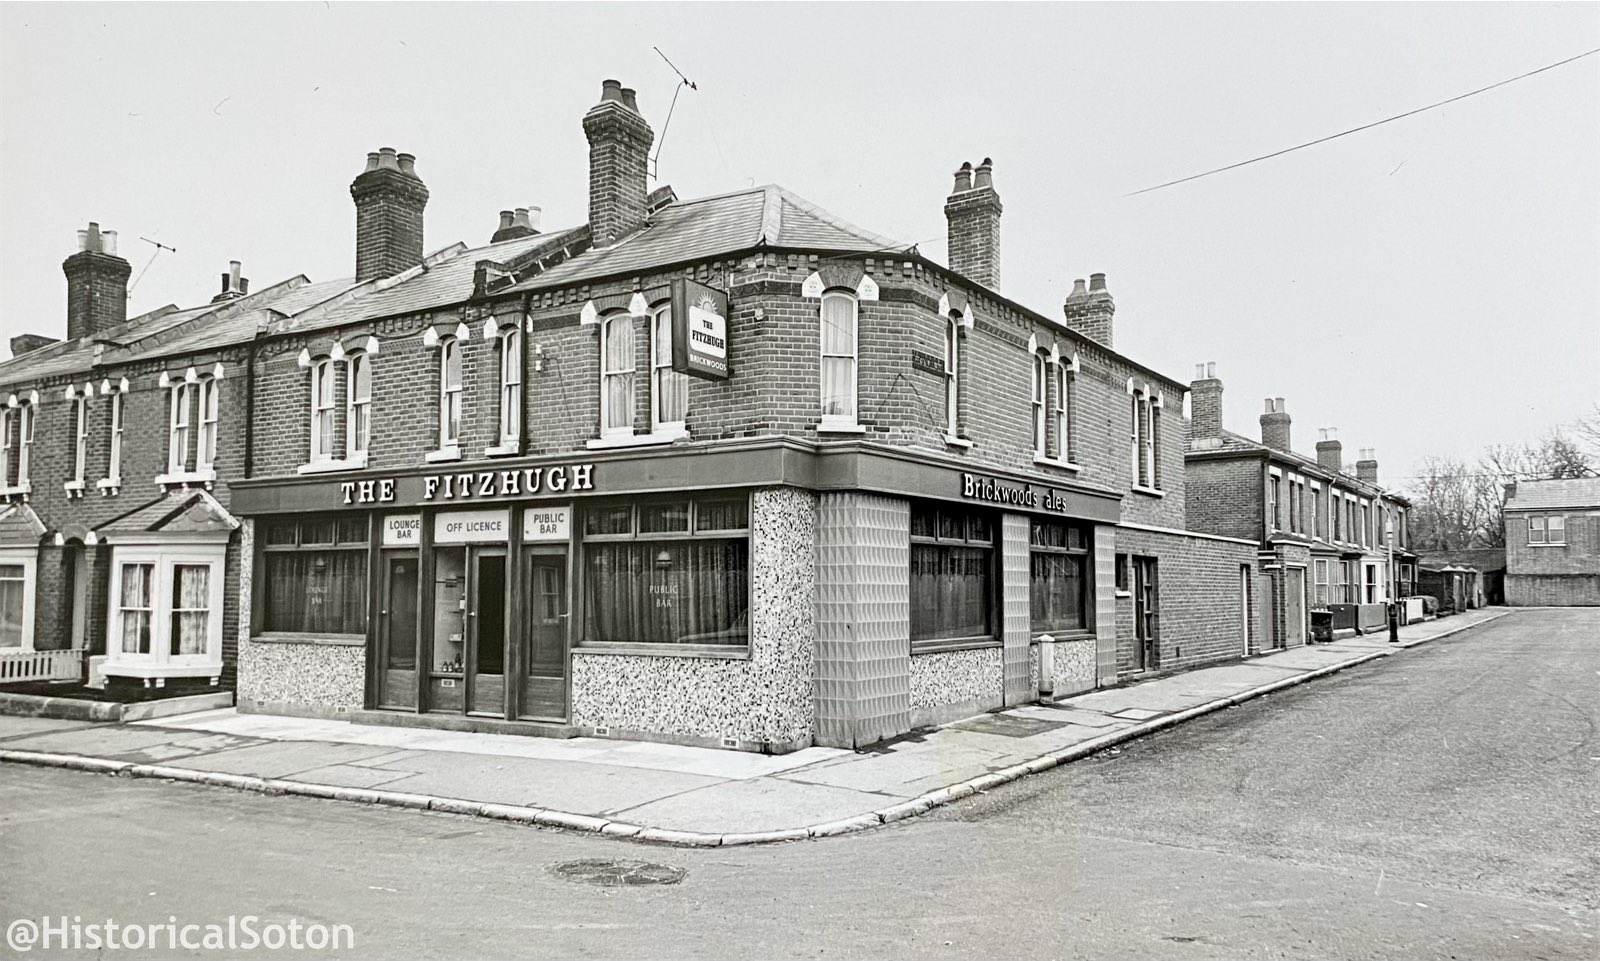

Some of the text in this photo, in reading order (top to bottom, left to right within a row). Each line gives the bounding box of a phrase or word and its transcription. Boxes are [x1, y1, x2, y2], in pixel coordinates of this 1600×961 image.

[702, 319, 713, 330] THE
[692, 330, 724, 349] FITZHUGH
[689, 353, 727, 370] BRICKWOODS
[341, 464, 593, 504] THE FITZHUGH
[964, 473, 1067, 511] Brickwoods ales
[389, 519, 420, 530] LOUNGE
[533, 512, 565, 525] PUBLIC
[446, 520, 502, 533] OFF LICENCE
[539, 523, 558, 535] BAR
[396, 529, 412, 539] BAR
[649, 584, 678, 594] PUBLIC
[656, 598, 672, 608] BAR
